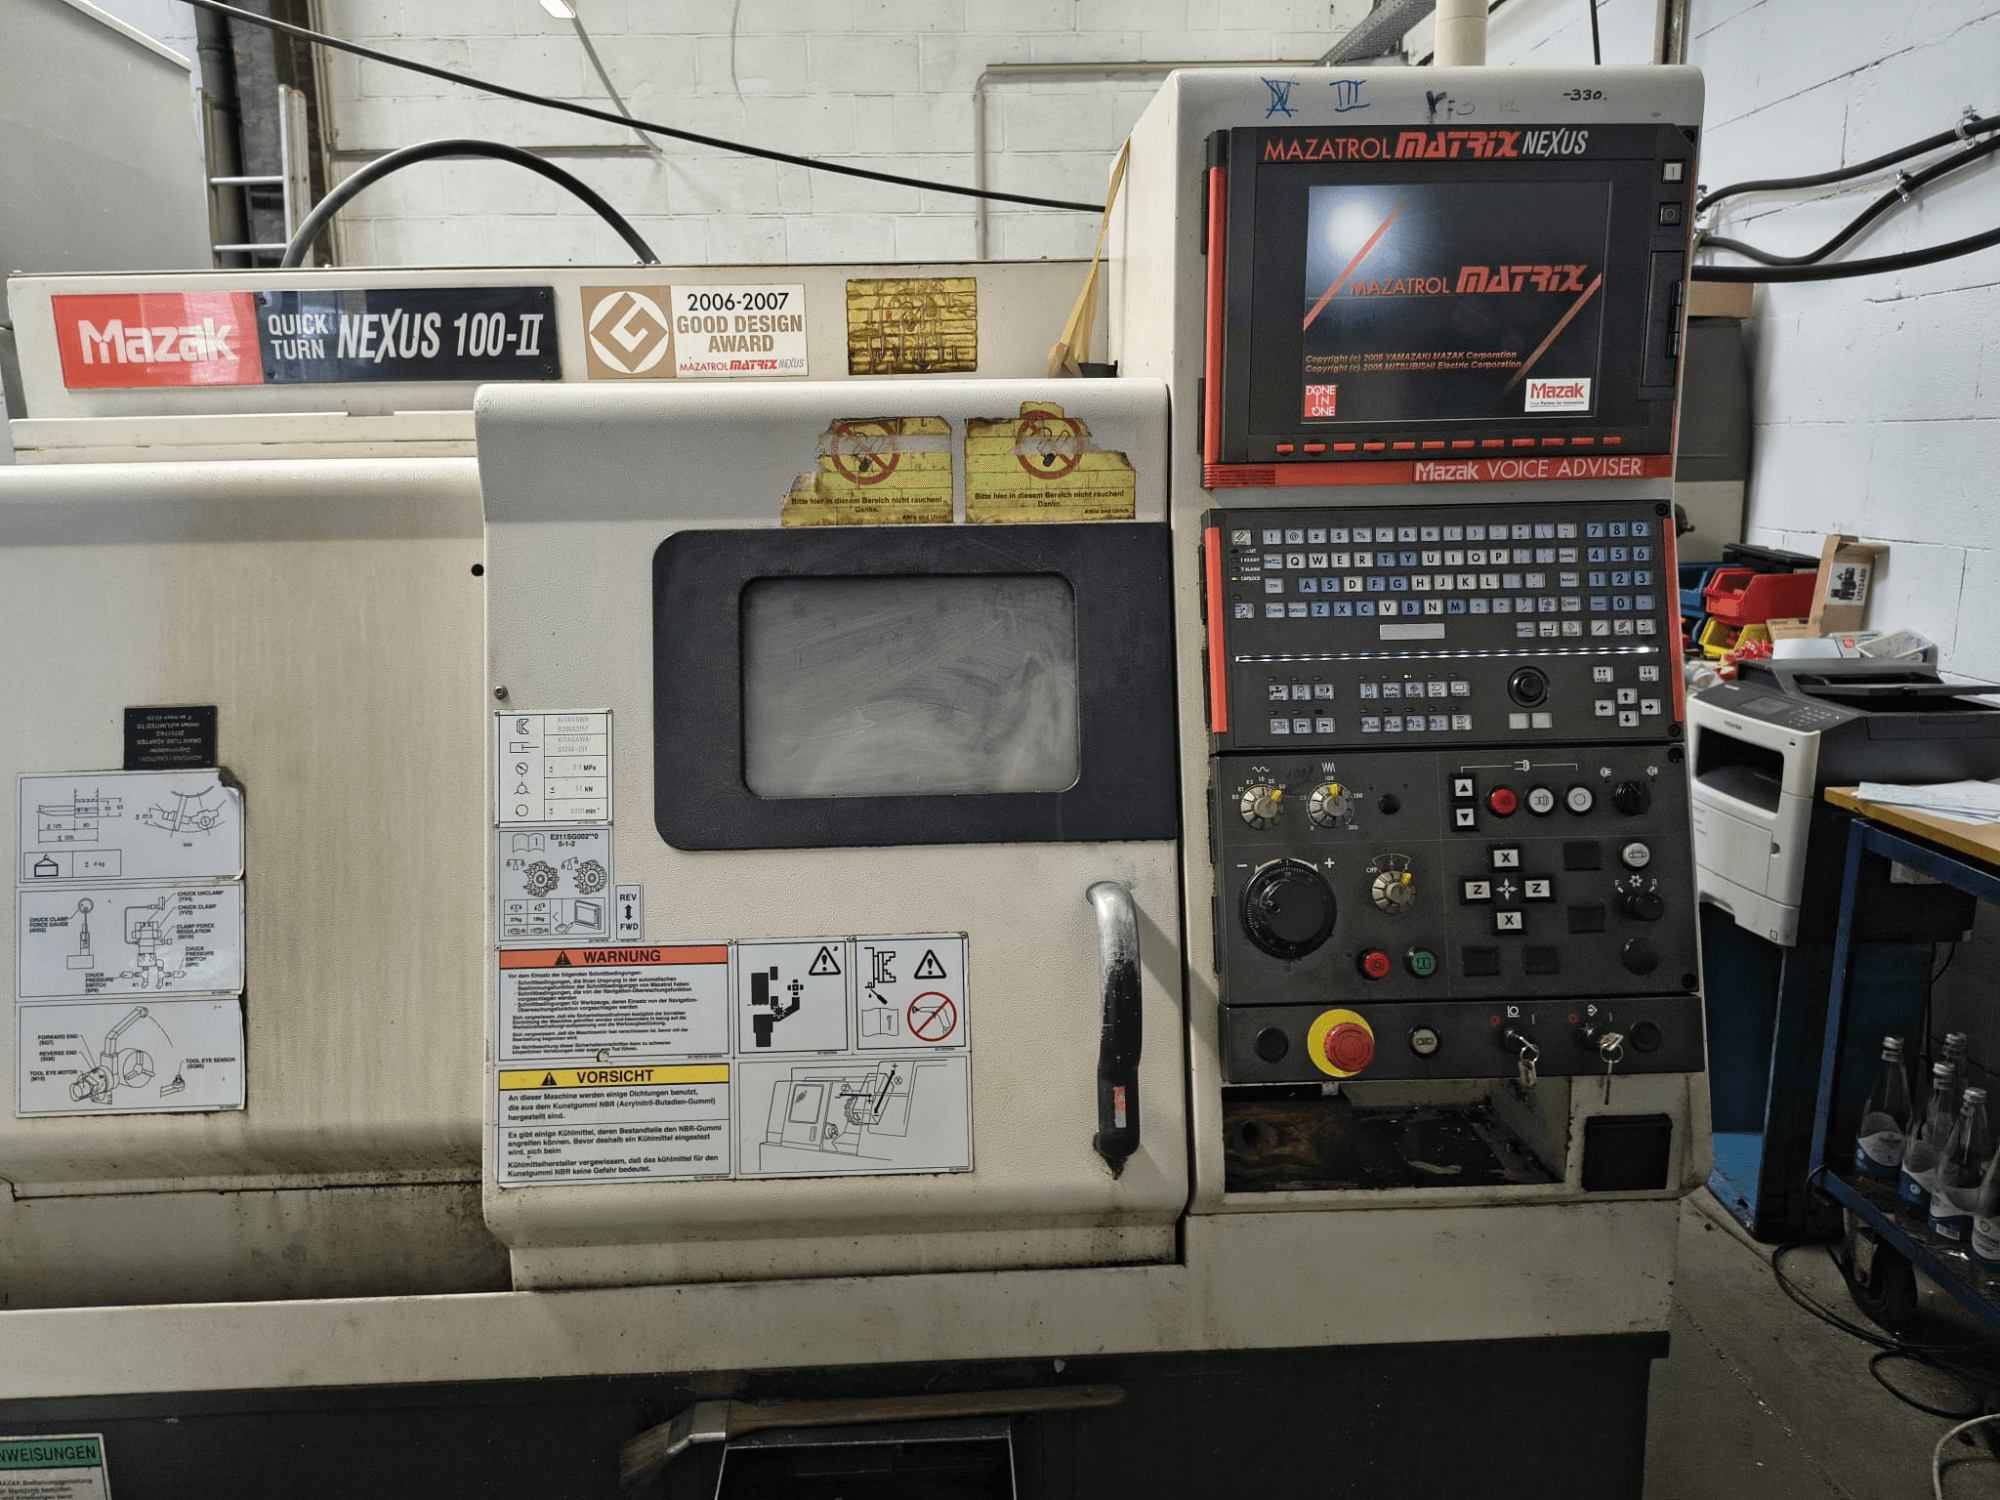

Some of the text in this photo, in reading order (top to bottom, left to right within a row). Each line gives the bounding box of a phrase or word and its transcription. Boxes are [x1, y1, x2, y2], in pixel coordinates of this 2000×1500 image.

[1264, 127, 1589, 161] MAZATROL MATRIX NEXUS
[1350, 265, 1588, 296] MAZATROL MATRIX
[687, 292, 789, 312] 2006-2007
[268, 314, 327, 335] QUICK
[677, 314, 803, 334] GOOD DESIGN
[78, 316, 239, 365] Mazak
[337, 308, 544, 363] NEXUS 100-II
[270, 340, 325, 360] TURN
[708, 334, 774, 353] AWARD
[1305, 351, 1517, 364] Copyright (c) 2005 YAMAZAKI MAZAK Corporation
[679, 357, 805, 372] MAZATROL MATRIX NEXUS
[1305, 360, 1522, 374] Copyright (c) 2005 MITSUBISHI Electric Corporation
[1305, 385, 1337, 396] DONE
[1531, 383, 1585, 399] Mazak
[1316, 395, 1330, 406] IN
[1311, 406, 1336, 417] ONE
[1415, 457, 1641, 482] Mazak VOICE ADVISER
[862, 496, 890, 504] Bereich
[891, 496, 909, 504] nicht
[911, 496, 943, 504] rauchen!
[975, 492, 992, 500] Bitte
[993, 492, 1007, 500] hier
[1045, 491, 1072, 499] Bereich
[1074, 490, 1092, 498] nicht
[1093, 490, 1124, 498] rauchen!
[1591, 525, 1643, 535] 7 8 9
[1291, 556, 1300, 566] Q
[1312, 556, 1323, 565] W
[1337, 556, 1343, 565] E
[1359, 555, 1366, 564] R
[1382, 555, 1389, 564] T
[1404, 555, 1412, 563] Y
[1427, 555, 1434, 563] U
[1471, 553, 1481, 562] O
[1496, 553, 1502, 561] P
[1592, 549, 1644, 560] 4 5 6
[1303, 577, 1491, 590] A S D F G H J K L
[1616, 574, 1623, 583] 2
[1639, 573, 1646, 583] 3
[1317, 605, 1323, 615] Z
[1339, 605, 1346, 614] X
[1361, 605, 1368, 614] C
[1384, 604, 1391, 613] V
[1407, 604, 1413, 612] B
[1429, 603, 1437, 612] N
[1450, 602, 1460, 611] M
[1617, 598, 1624, 608] 0
[1501, 853, 1511, 863] X
[1472, 883, 1542, 895] Z Z
[619, 893, 637, 901] REV
[620, 923, 639, 931] FWD
[1504, 915, 1514, 926] X
[583, 950, 661, 963] WARNUNG
[577, 1069, 654, 1084] VORSICHT
